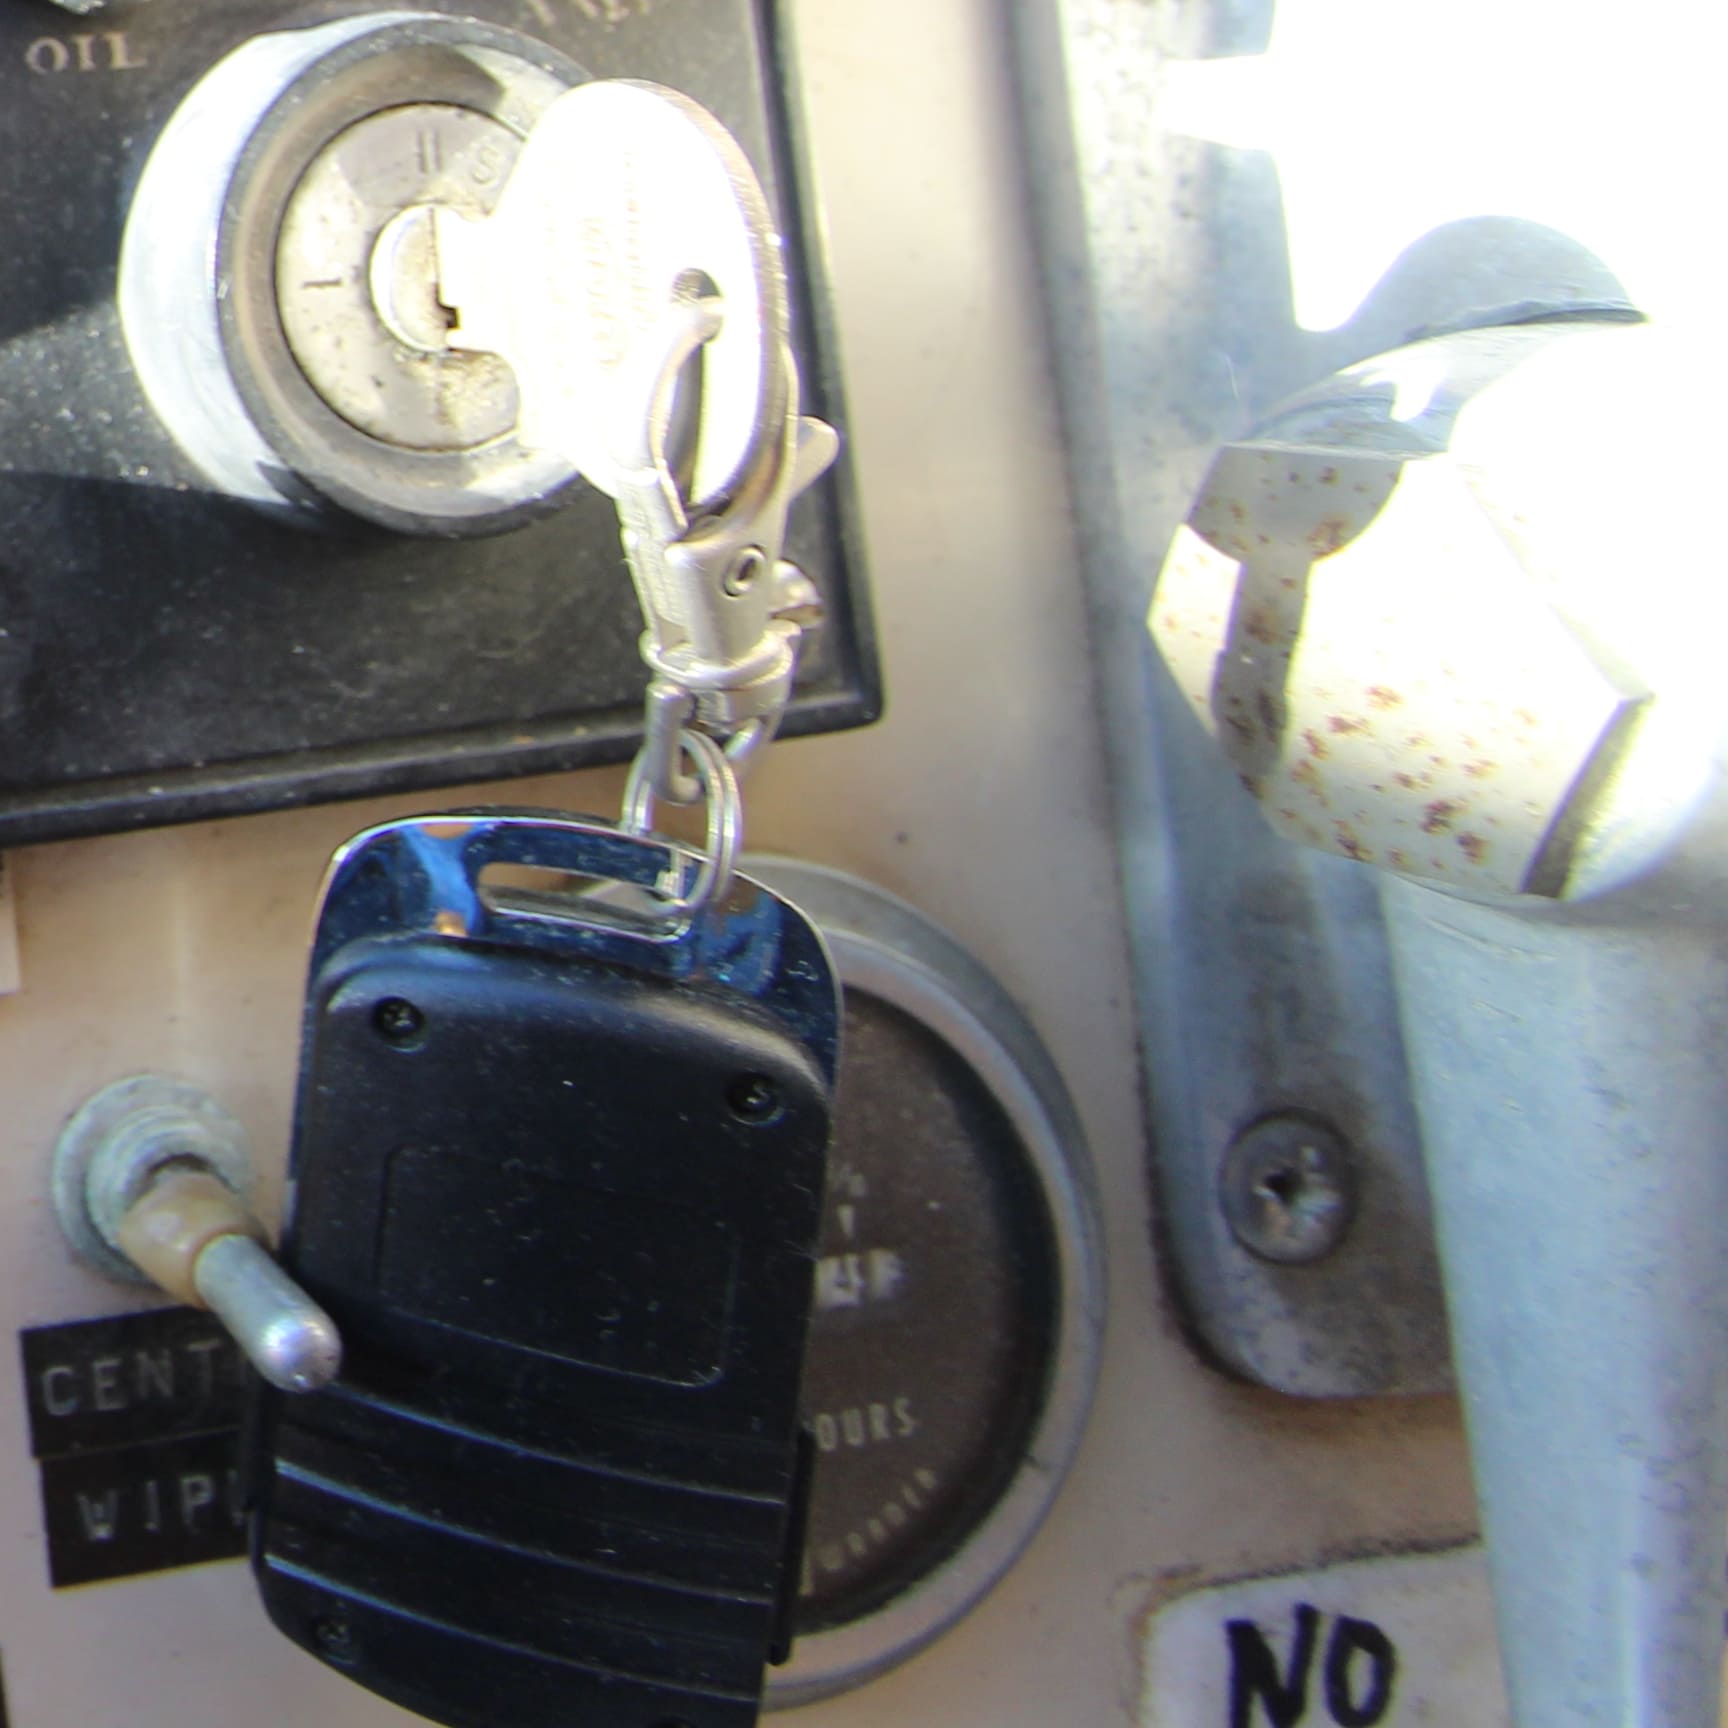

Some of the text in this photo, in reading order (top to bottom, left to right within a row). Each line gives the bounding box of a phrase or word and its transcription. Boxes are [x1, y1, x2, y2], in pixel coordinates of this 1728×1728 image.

[25, 30, 148, 75] OIL
[44, 1338, 223, 1418] CENT
[812, 1396, 917, 1453] OURS
[77, 1469, 251, 1542] WIP
[1225, 1603, 1398, 1728] NO
